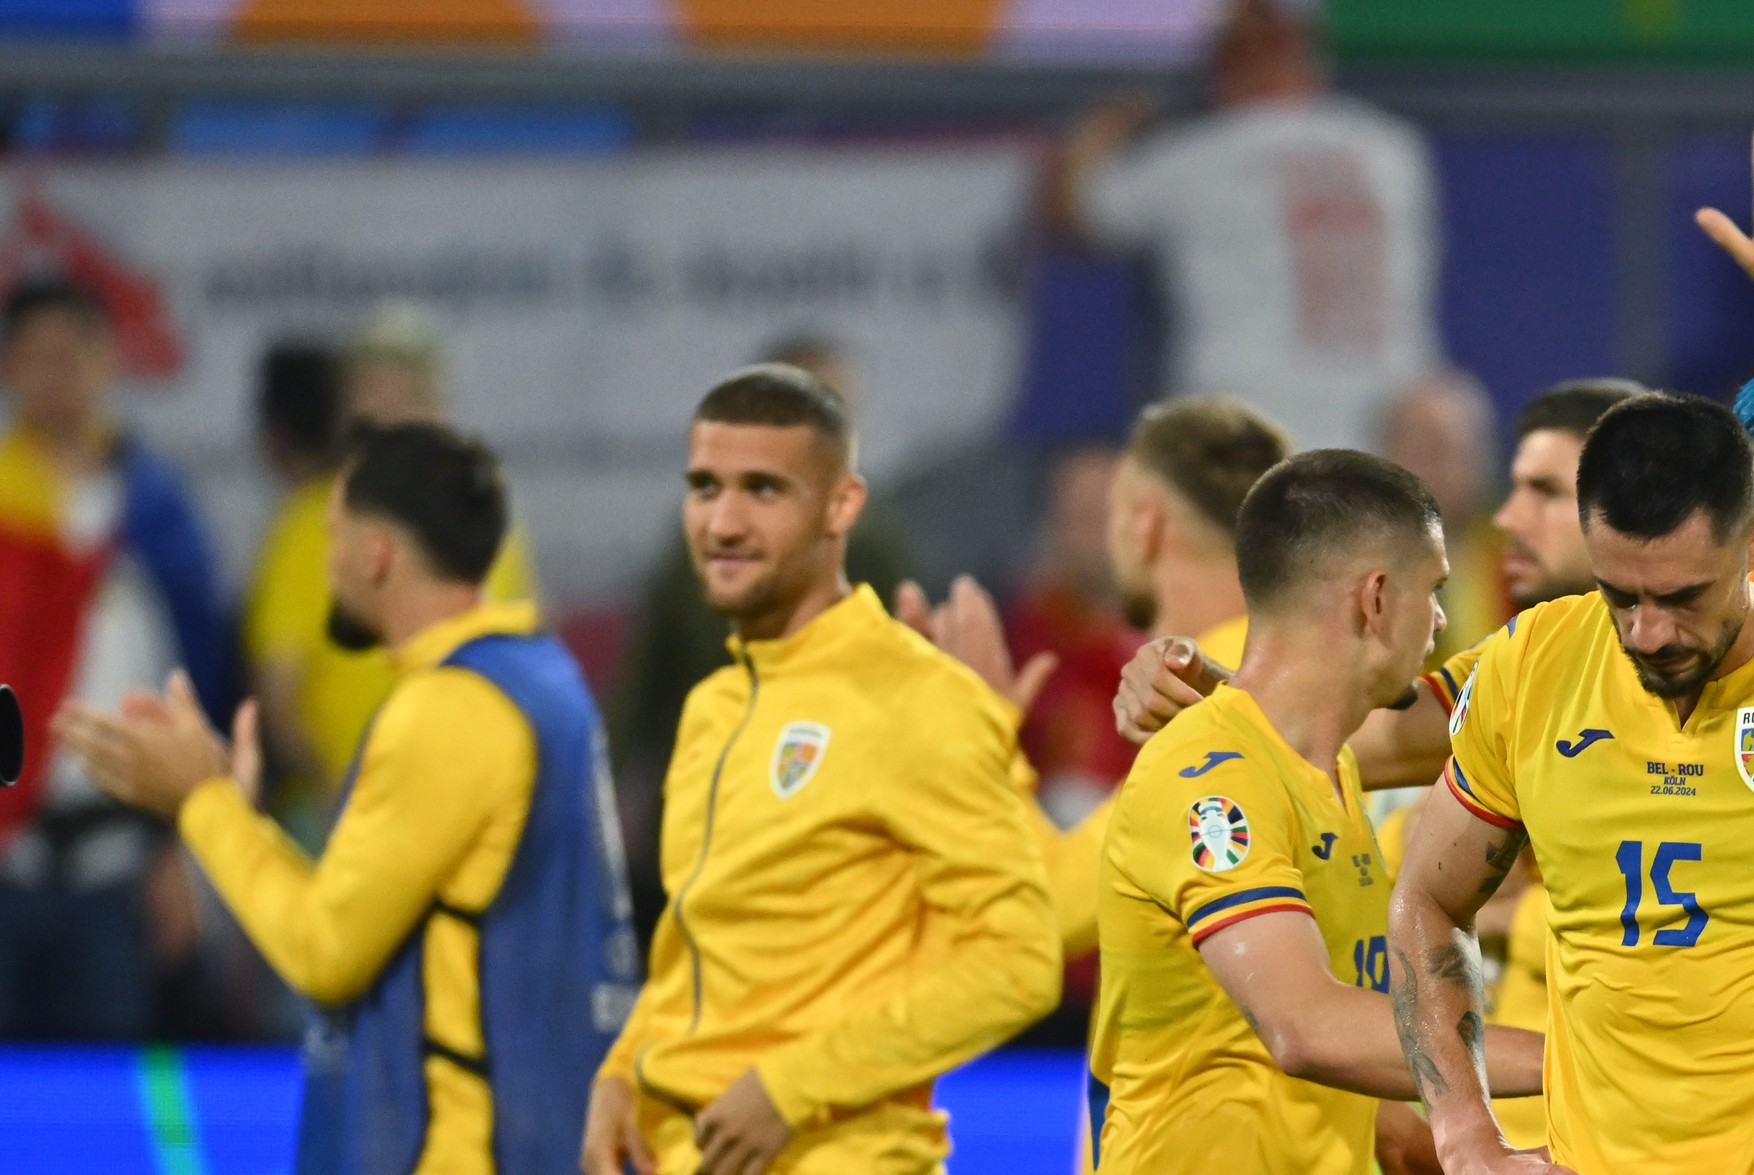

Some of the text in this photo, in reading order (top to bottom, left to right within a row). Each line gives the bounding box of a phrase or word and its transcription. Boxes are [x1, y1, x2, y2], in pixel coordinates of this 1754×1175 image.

[1647, 762, 1668, 775] BEL
[1678, 764, 1704, 776] ROU
[1663, 776, 1686, 786] KÖLN
[1650, 785, 1697, 796] 22.06.2024
[1615, 840, 1710, 948] 15
